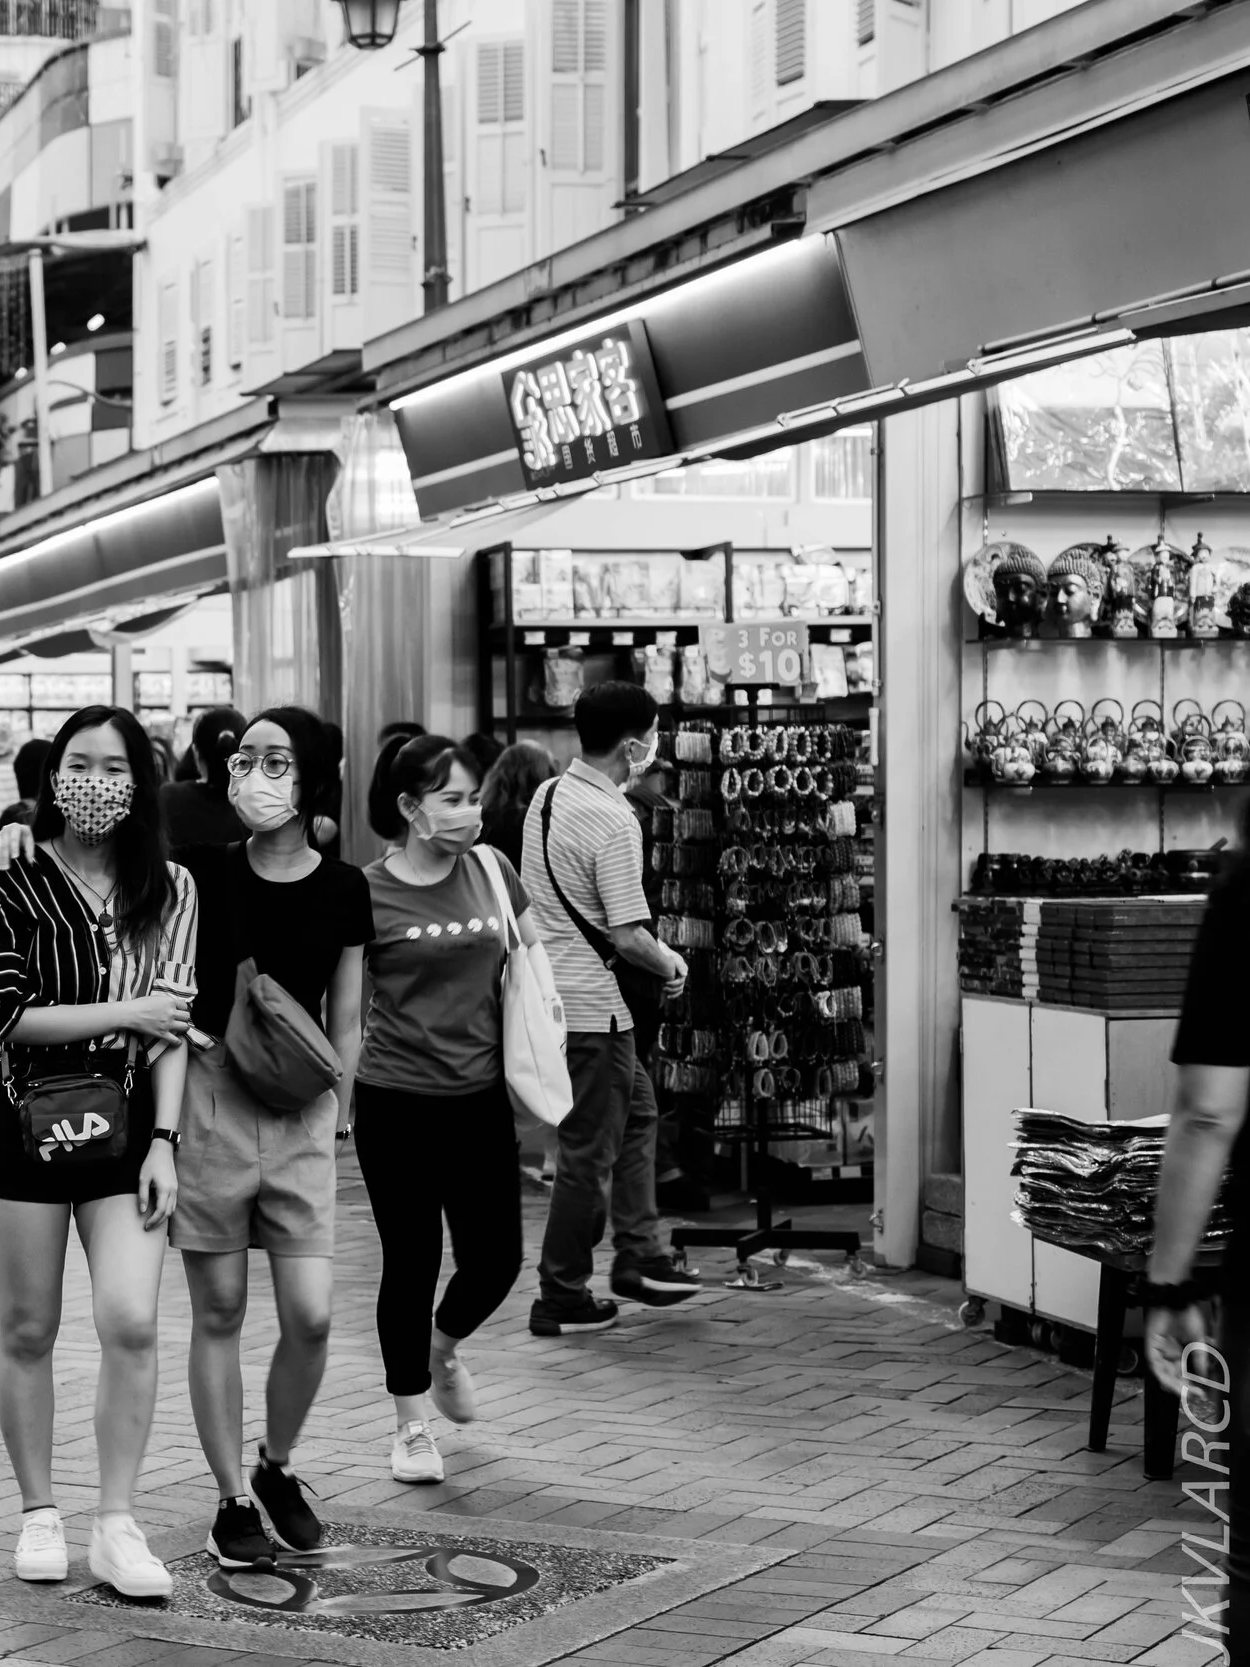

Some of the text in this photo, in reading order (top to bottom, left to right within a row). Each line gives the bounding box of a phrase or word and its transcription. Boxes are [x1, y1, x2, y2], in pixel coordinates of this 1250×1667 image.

[738, 628, 798, 648] 3 FOR
[738, 650, 800, 682] $10
[38, 1112, 110, 1162] FILA
